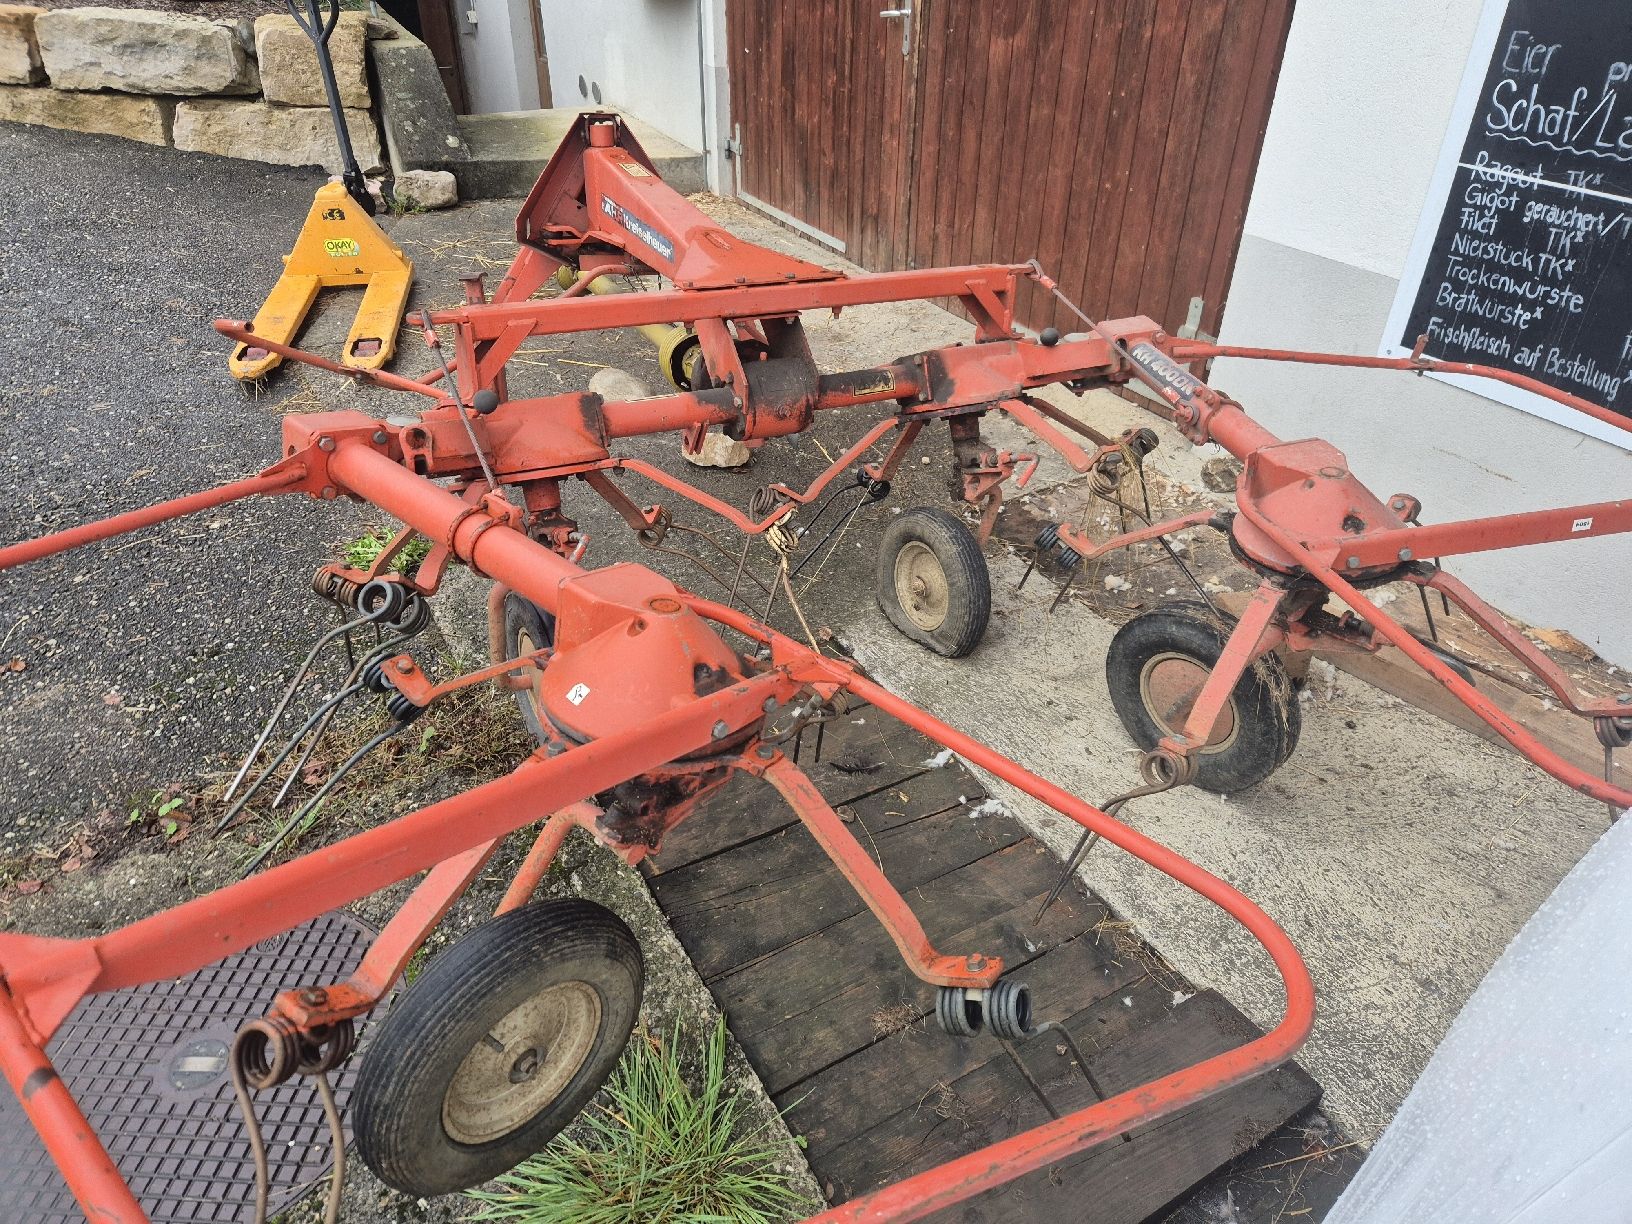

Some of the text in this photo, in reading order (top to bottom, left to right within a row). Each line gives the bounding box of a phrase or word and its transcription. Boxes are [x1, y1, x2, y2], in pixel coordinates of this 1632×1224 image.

[1503, 30, 1562, 75] Eier
[1470, 150, 1545, 195] Ragout
[1464, 183, 1520, 216] Gigot
[1459, 207, 1498, 236] Filet
[326, 240, 352, 252] OKAY
[1450, 233, 1534, 272] Nierstück
[1445, 254, 1584, 313] Trockenwürste
[1426, 316, 1511, 359] Frischfleisch
[1513, 344, 1542, 372] auf
